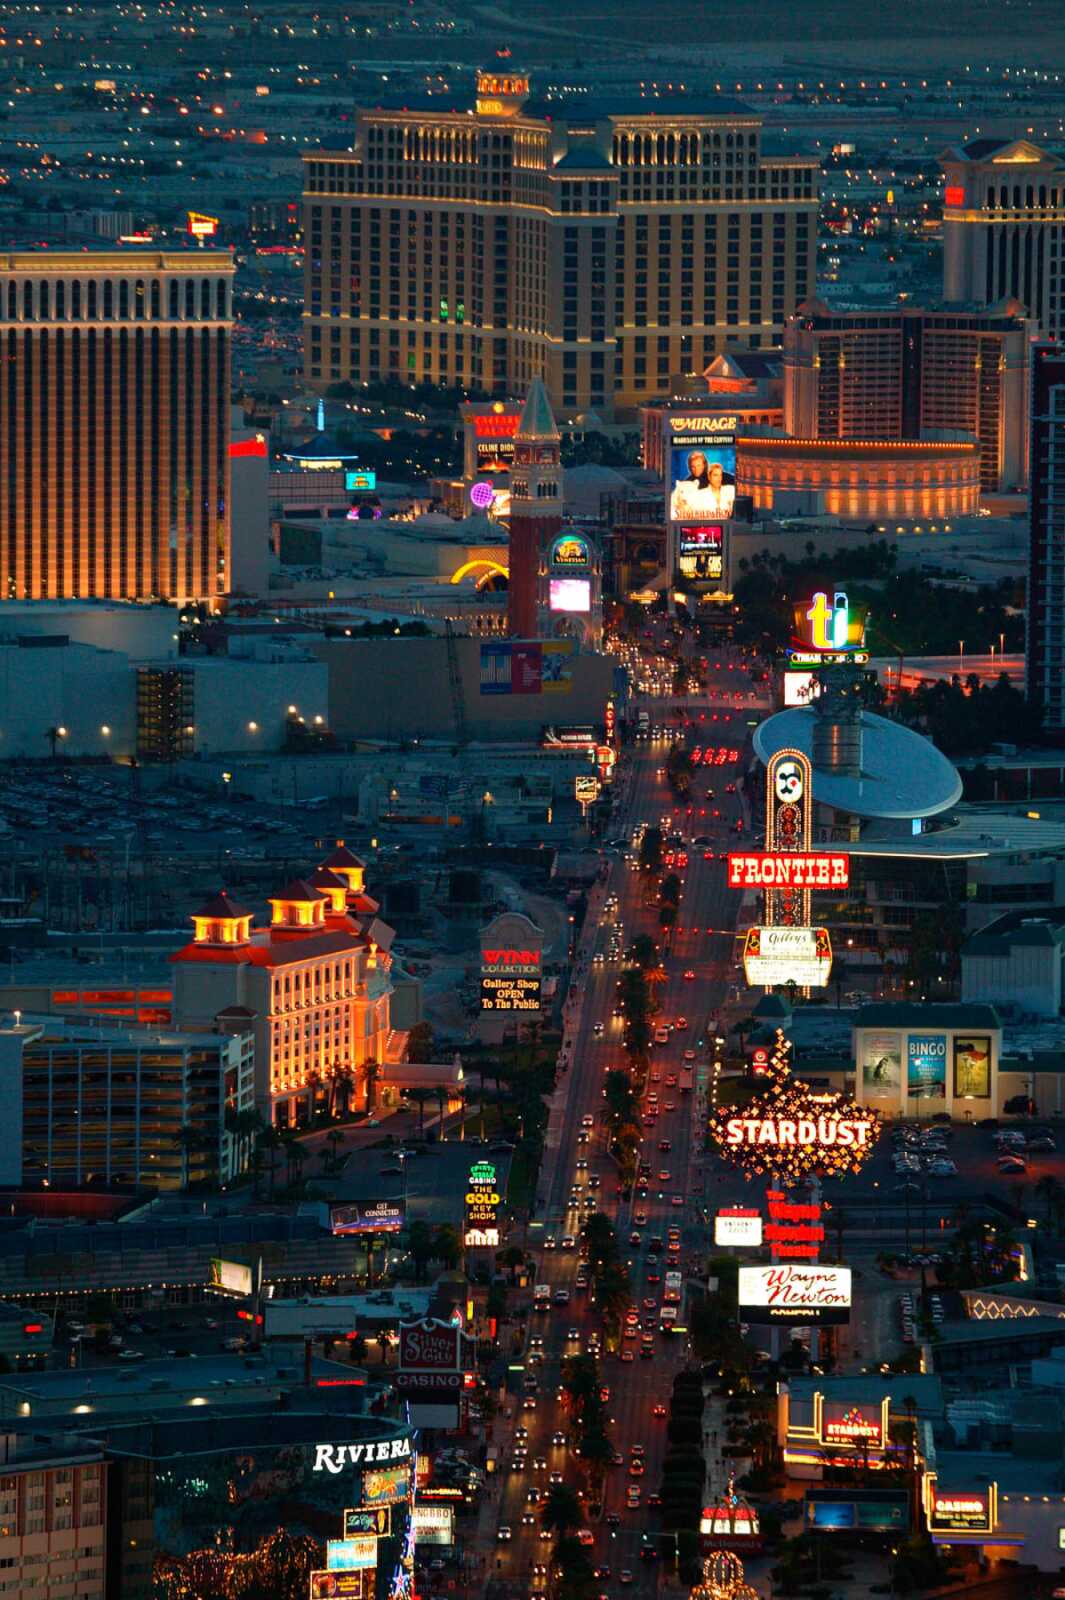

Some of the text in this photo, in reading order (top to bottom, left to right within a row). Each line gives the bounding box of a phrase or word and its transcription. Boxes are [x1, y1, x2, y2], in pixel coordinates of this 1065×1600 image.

[687, 417, 737, 431] MIRAGE
[478, 443, 514, 452] CELINE DION
[731, 858, 848, 883] FRONTIER
[482, 949, 541, 965] WYNN
[481, 965, 540, 973] COLLECTION
[483, 979, 539, 990] Gallery Shop
[497, 990, 524, 998] OPEN
[482, 998, 540, 1009] To The Public
[909, 1042, 945, 1055] BINGO
[727, 1119, 871, 1145] STARDUST
[465, 1193, 500, 1204] GOLD
[365, 1209, 399, 1217] CONNECTED
[469, 1212, 496, 1220] SHOPS
[762, 1267, 837, 1291] Wayne
[766, 1285, 849, 1304] Newton
[406, 1332, 453, 1362] Silver
[397, 1375, 460, 1386] CASINO
[827, 1424, 879, 1437] STARDUST
[312, 1438, 411, 1474] RIVIERA
[936, 1500, 983, 1512] CASINO
